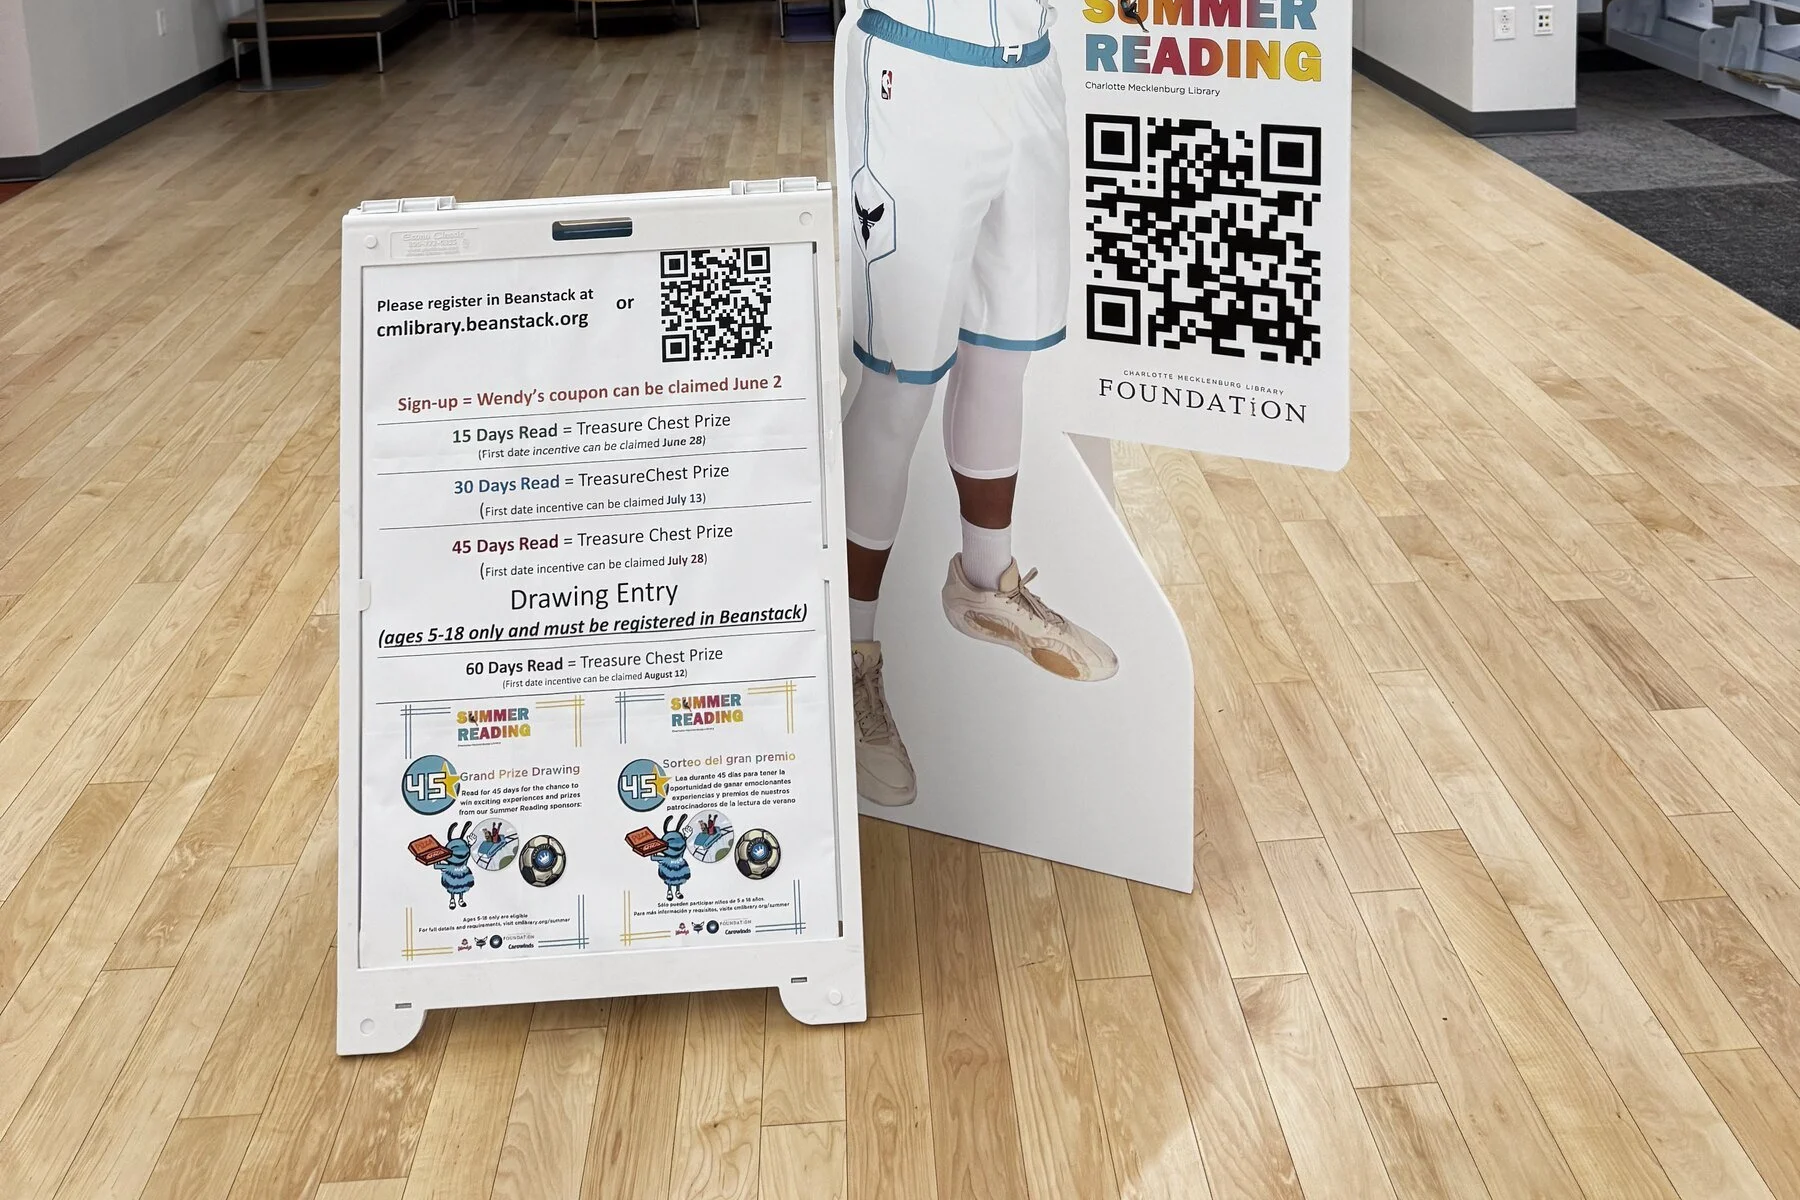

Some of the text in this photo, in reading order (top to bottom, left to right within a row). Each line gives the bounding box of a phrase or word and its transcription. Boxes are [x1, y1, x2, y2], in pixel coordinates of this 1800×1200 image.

[1085, 34, 1322, 82] READING
[1085, 82, 1220, 96] Charlotte Mecklenburg Library
[378, 289, 593, 312] Please register in Beanstack at
[617, 298, 634, 309] or
[377, 312, 588, 337] cmlibrary.beanstack.org
[398, 397, 458, 413] Sign-up
[463, 397, 472, 405] =
[550, 388, 608, 402] coupon
[613, 386, 639, 397] can
[645, 382, 663, 395] be
[668, 377, 728, 393] claimed
[733, 378, 768, 390] June
[774, 376, 782, 388] 2
[1124, 370, 1284, 395] CHARLOTTE MECKLENBURG LIBRARY
[453, 414, 730, 443] 15 Days Read = Treasure Chest Prize
[479, 435, 706, 460] (First date incentive can be claimed June 28)
[454, 480, 473, 494] 30
[479, 480, 516, 494] Days
[521, 474, 559, 490] Read
[565, 477, 573, 485] =
[694, 464, 729, 478] Prize
[480, 493, 706, 519] (First date incentive can be claimed July 13)
[452, 524, 732, 554] 45 Days Read = Treasure Chest Prize
[480, 553, 707, 580] (First date incentive can be claimed July 28)
[512, 583, 678, 610] Drawing Entry
[379, 604, 807, 648] (ages 5-18 only and must be registered in Beanstack)
[466, 662, 483, 675] 60
[489, 662, 523, 676] Days
[528, 657, 562, 672] Read
[580, 656, 641, 668] Treasure
[646, 651, 684, 664] Chest
[690, 648, 722, 661] Prize
[503, 680, 523, 689] (First
[545, 677, 581, 685] incentive
[600, 674, 609, 682] be
[612, 672, 642, 681] claimed
[644, 671, 672, 680] August
[675, 669, 687, 678] 12)
[670, 693, 742, 711] SUMMER
[456, 707, 530, 725] SUMMER
[671, 710, 744, 727] READING
[457, 724, 532, 741] READING
[663, 752, 796, 768] Sorteo del gran premio
[460, 765, 580, 782] Grand Prize Drawing
[405, 772, 447, 801] 45
[462, 788, 478, 796] Read
[620, 773, 658, 799] 45
[670, 783, 712, 792] oportunidad
[672, 793, 714, 801] experiencias
[503, 795, 544, 804] experiences
[667, 802, 718, 811] patrocinadores
